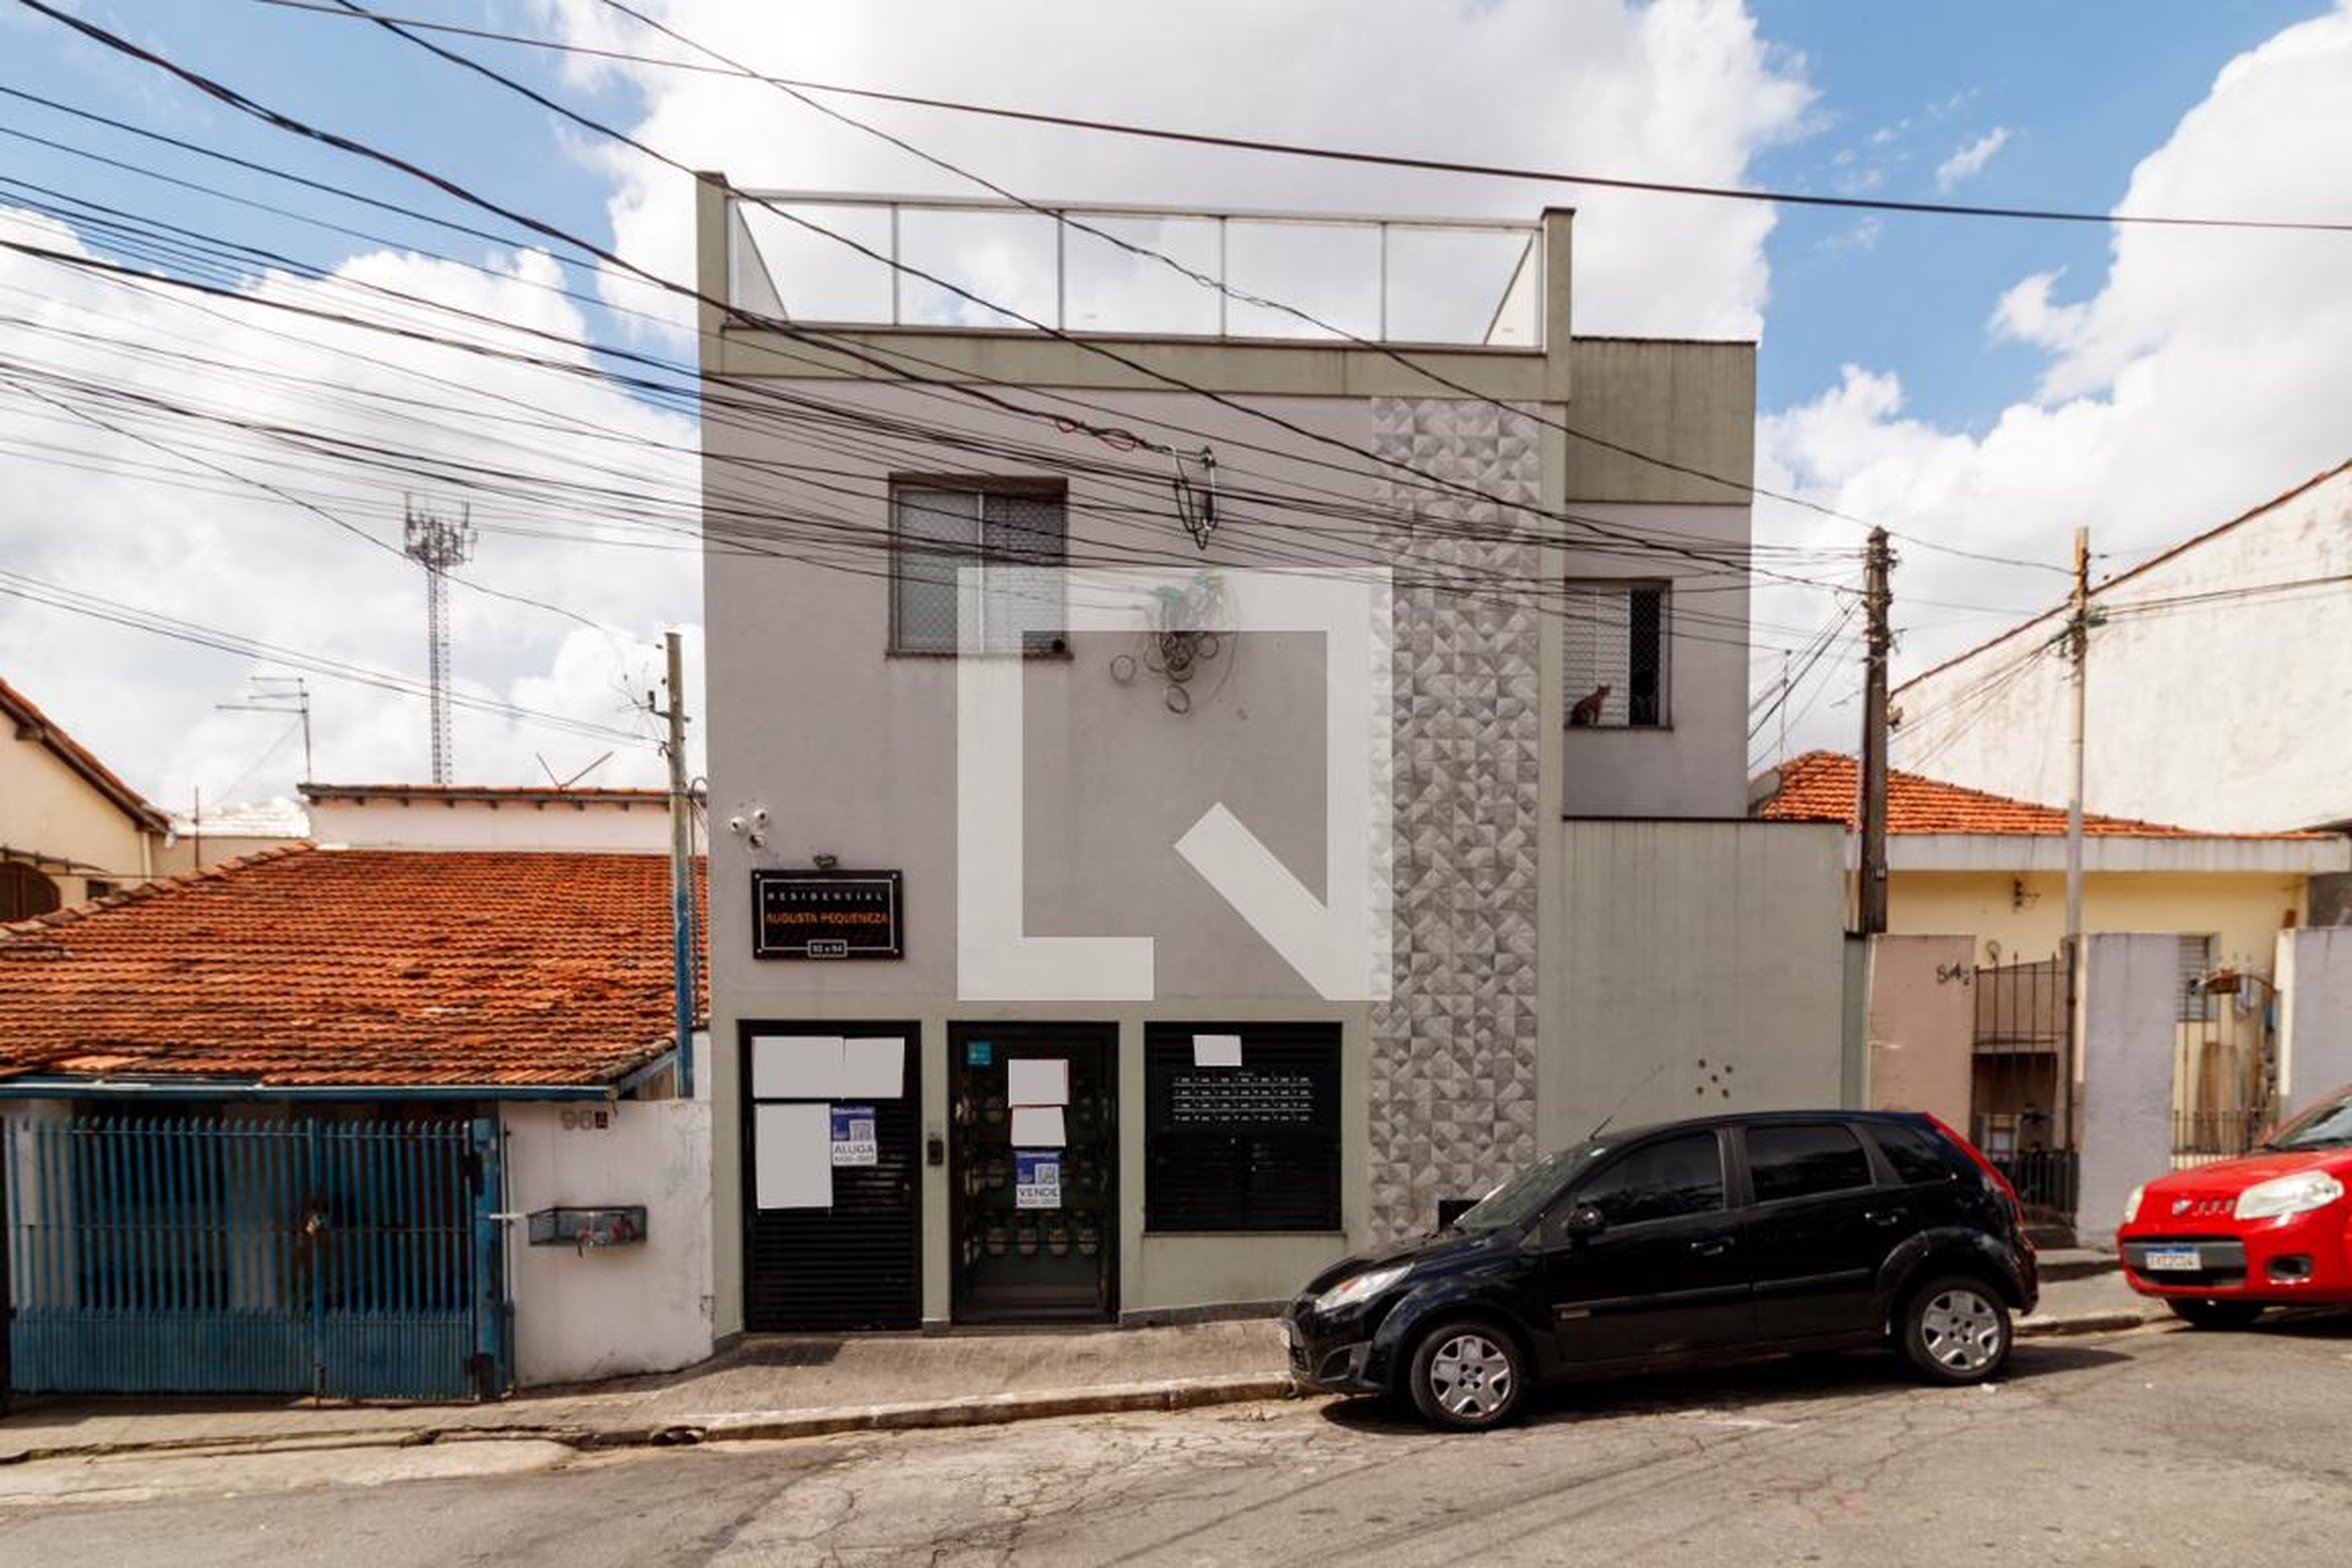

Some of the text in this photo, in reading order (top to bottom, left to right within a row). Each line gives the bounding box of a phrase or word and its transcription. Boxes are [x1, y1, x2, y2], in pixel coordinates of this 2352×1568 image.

[766, 913, 818, 924] AUGUSTA
[834, 1145, 875, 1155] ALUGA
[1018, 1187, 1059, 1197] VENDE
